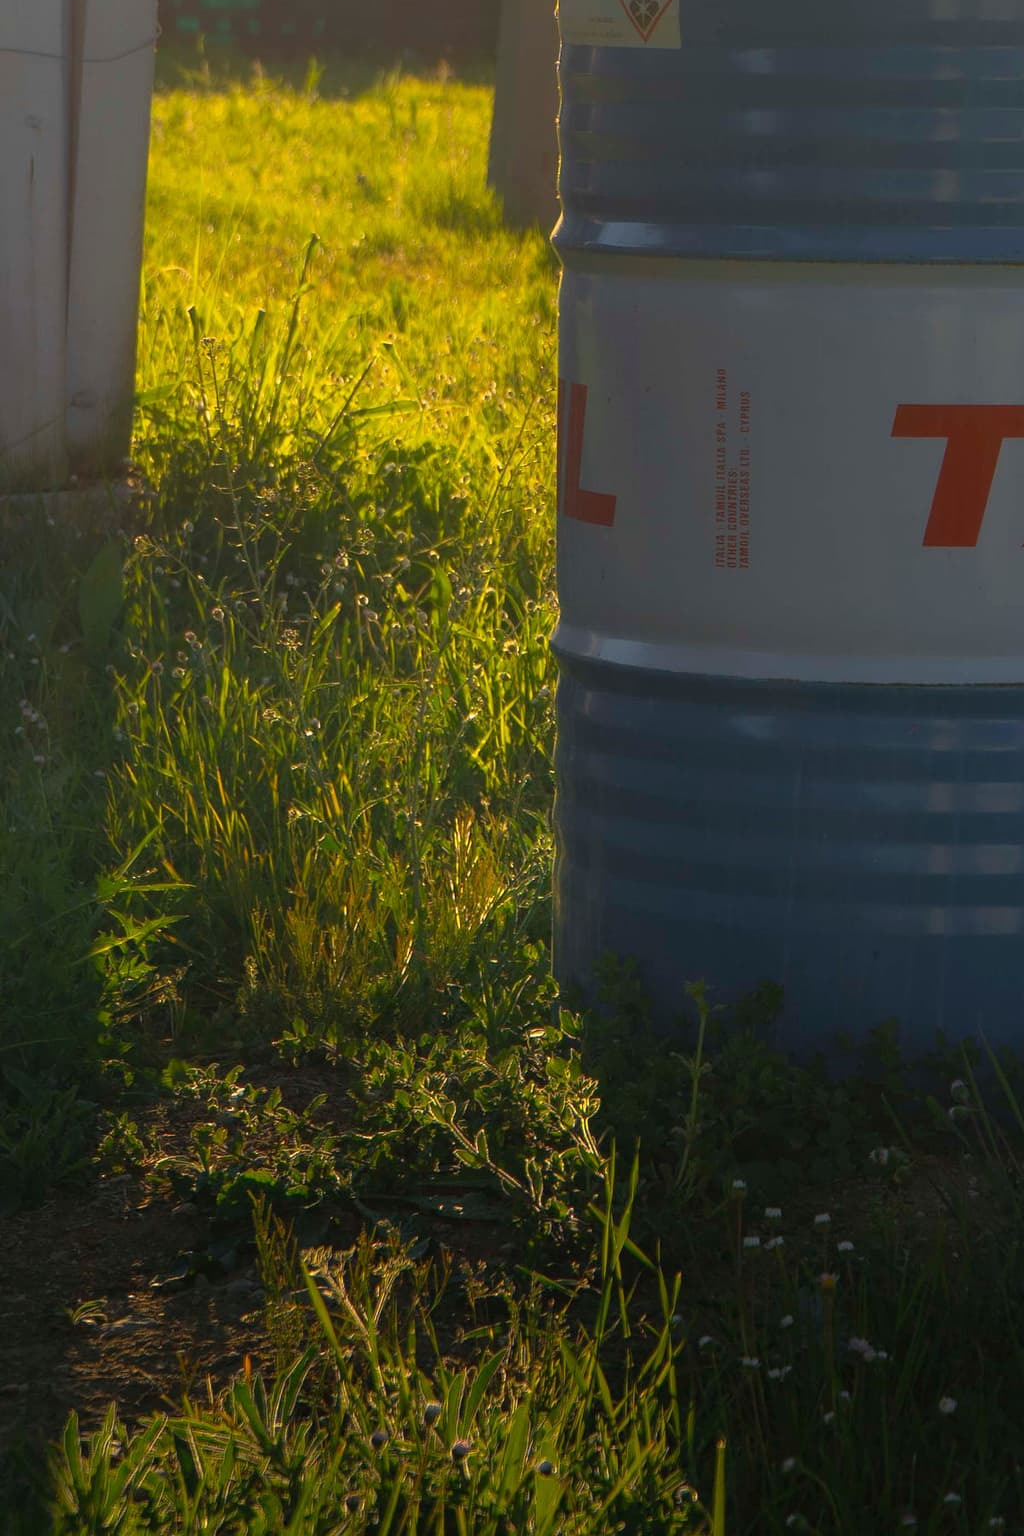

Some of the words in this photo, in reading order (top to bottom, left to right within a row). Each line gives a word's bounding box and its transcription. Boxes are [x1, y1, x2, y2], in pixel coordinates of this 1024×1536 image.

[716, 368, 727, 411] MILANO
[740, 391, 750, 433] CYPRUS
[716, 422, 726, 443] SPA
[716, 448, 726, 480] ITALIA
[715, 485, 725, 523] TAMOIL
[739, 471, 750, 526] OVERSEAS
[715, 535, 725, 568] ITALIA
[727, 535, 737, 568] OTHER
[739, 531, 750, 569] TAMOIL
